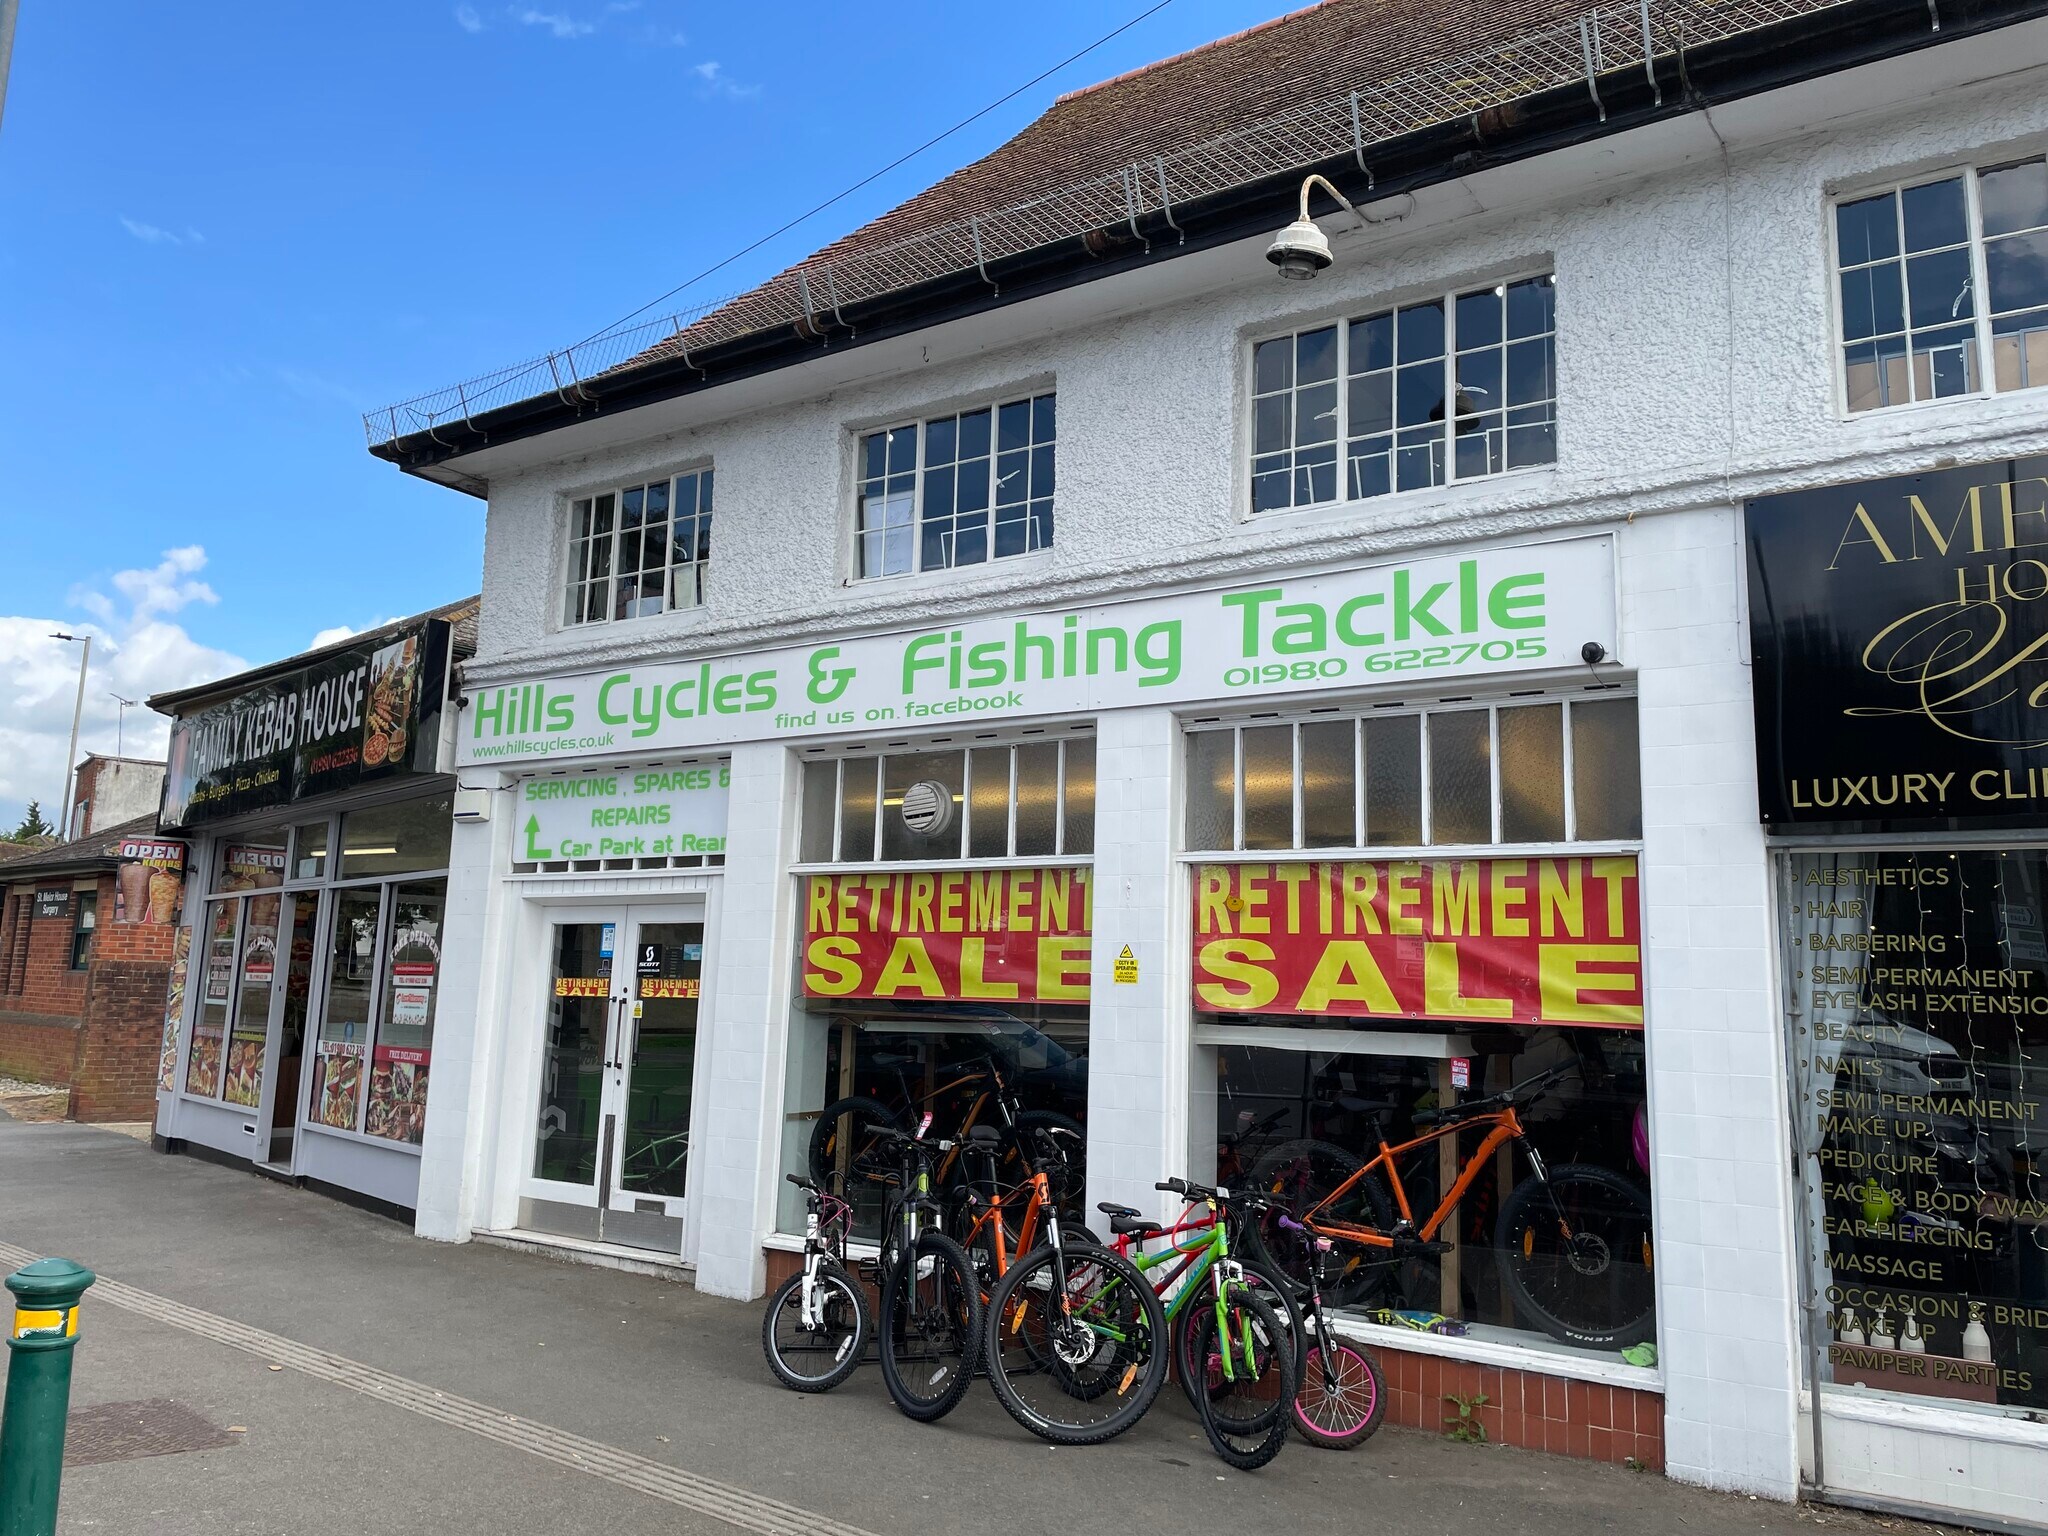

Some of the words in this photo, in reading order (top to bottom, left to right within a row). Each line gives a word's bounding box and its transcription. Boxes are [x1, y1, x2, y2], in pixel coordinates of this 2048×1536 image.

[1824, 477, 2048, 571] AME
[1953, 559, 2048, 606] HO
[474, 684, 575, 738] Hills
[598, 664, 777, 738] Cycles
[806, 647, 856, 704] &
[902, 615, 1182, 695] Fishing
[1222, 560, 1546, 658] Tackle
[1224, 658, 1347, 687] 01980
[1364, 637, 1547, 672] 622705
[192, 715, 243, 779] FAMILY
[243, 691, 297, 763] KEBAB
[300, 666, 367, 746] HOUSE
[775, 711, 816, 729] find
[827, 712, 854, 725] us
[905, 690, 1023, 718] facebook
[473, 732, 614, 758] www.hillscycles.co.uk
[209, 782, 231, 801] Burgers
[236, 776, 250, 791] Pizza
[254, 770, 279, 787] Chicken
[525, 777, 617, 801] SERVICING
[634, 769, 711, 794] SPARES
[1792, 772, 1955, 807] LUXURY
[1970, 767, 2048, 800] CLI
[591, 804, 671, 828] REPAIRS
[123, 844, 181, 859] OPEN
[560, 839, 592, 857] Car
[600, 837, 645, 856] Park
[653, 835, 674, 853] at
[1806, 868, 1949, 886] AESTHETICS
[1199, 858, 1637, 938] RETIREMENT
[1807, 902, 1862, 918] HAIR
[1810, 934, 1946, 952] BARBERING
[804, 936, 1091, 1000] SALE
[1196, 939, 1643, 1022] SALE
[1812, 967, 1867, 984] SEMI
[1876, 969, 2033, 988] PERMANENT
[555, 988, 608, 997] SALE
[556, 978, 610, 988] RETIREMENT
[641, 988, 699, 998] SALE
[642, 979, 700, 988] RETIREMENT
[1813, 991, 1916, 1011] EYELASH
[1927, 995, 2048, 1015] EXTENSIO
[1814, 1024, 1905, 1042] BEAUTY
[389, 1050, 400, 1059] FREE
[1816, 1056, 1883, 1076] NAILS
[1817, 1090, 1871, 1110] SEMI
[1882, 1095, 2039, 1120] PERMANENT
[1818, 1115, 1887, 1136] MAKE
[1895, 1120, 1927, 1139] UP
[1820, 1149, 1938, 1175] PEDICURE
[1822, 1183, 1882, 1205] FACE
[1891, 1189, 1907, 1206] &
[1916, 1190, 1987, 1213] BODY
[1823, 1217, 1867, 1237] EAR
[1878, 1223, 1993, 1250] PIERCING
[1825, 1250, 1943, 1281] MASSAGE
[1825, 1285, 1959, 1318] OCCASION
[1968, 1303, 1986, 1322] &
[1995, 1305, 2048, 1329] BRID
[1566, 1331, 1614, 1342] KENDA
[1827, 1311, 1896, 1338] MAKE
[1905, 1322, 1936, 1341] UP
[1829, 1346, 1924, 1376] PAMPER
[1934, 1360, 2033, 1391] PARTIES
